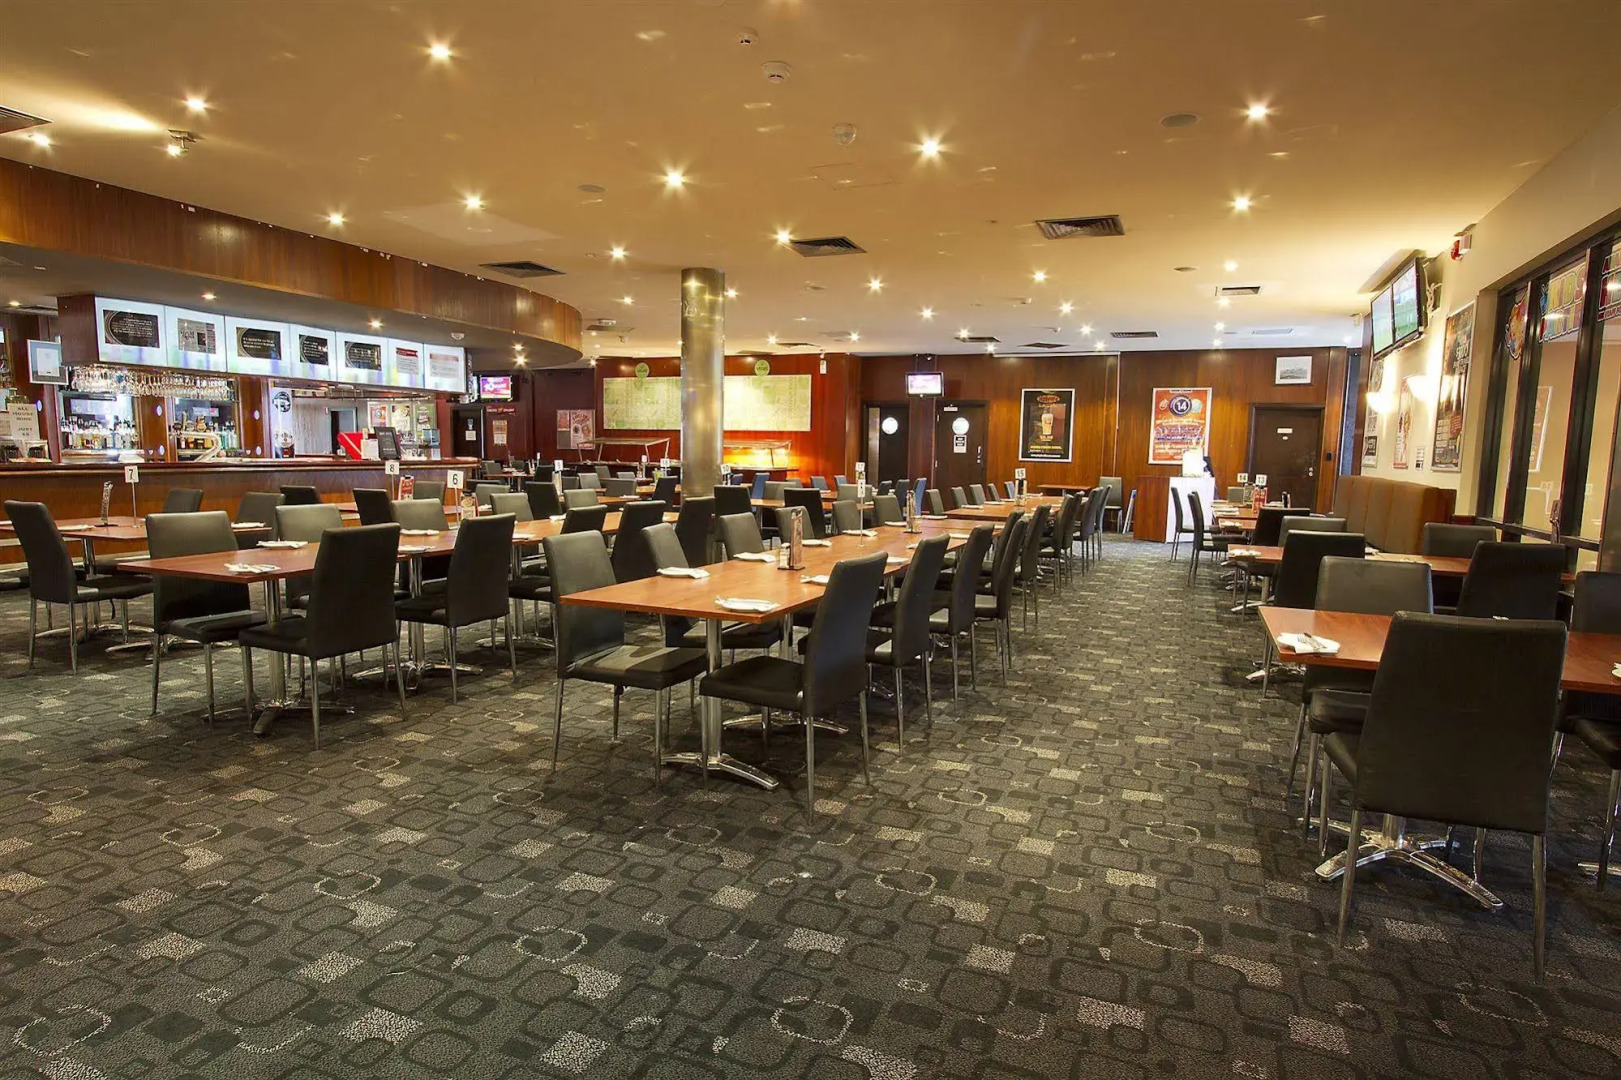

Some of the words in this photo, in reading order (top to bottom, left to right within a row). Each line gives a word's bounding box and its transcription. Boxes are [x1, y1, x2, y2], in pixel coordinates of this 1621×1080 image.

[1547, 262, 1586, 313] KIDS
[1176, 401, 1187, 411] 14
[128, 468, 134, 481] 7
[389, 464, 395, 473] 8
[452, 473, 459, 485] 6
